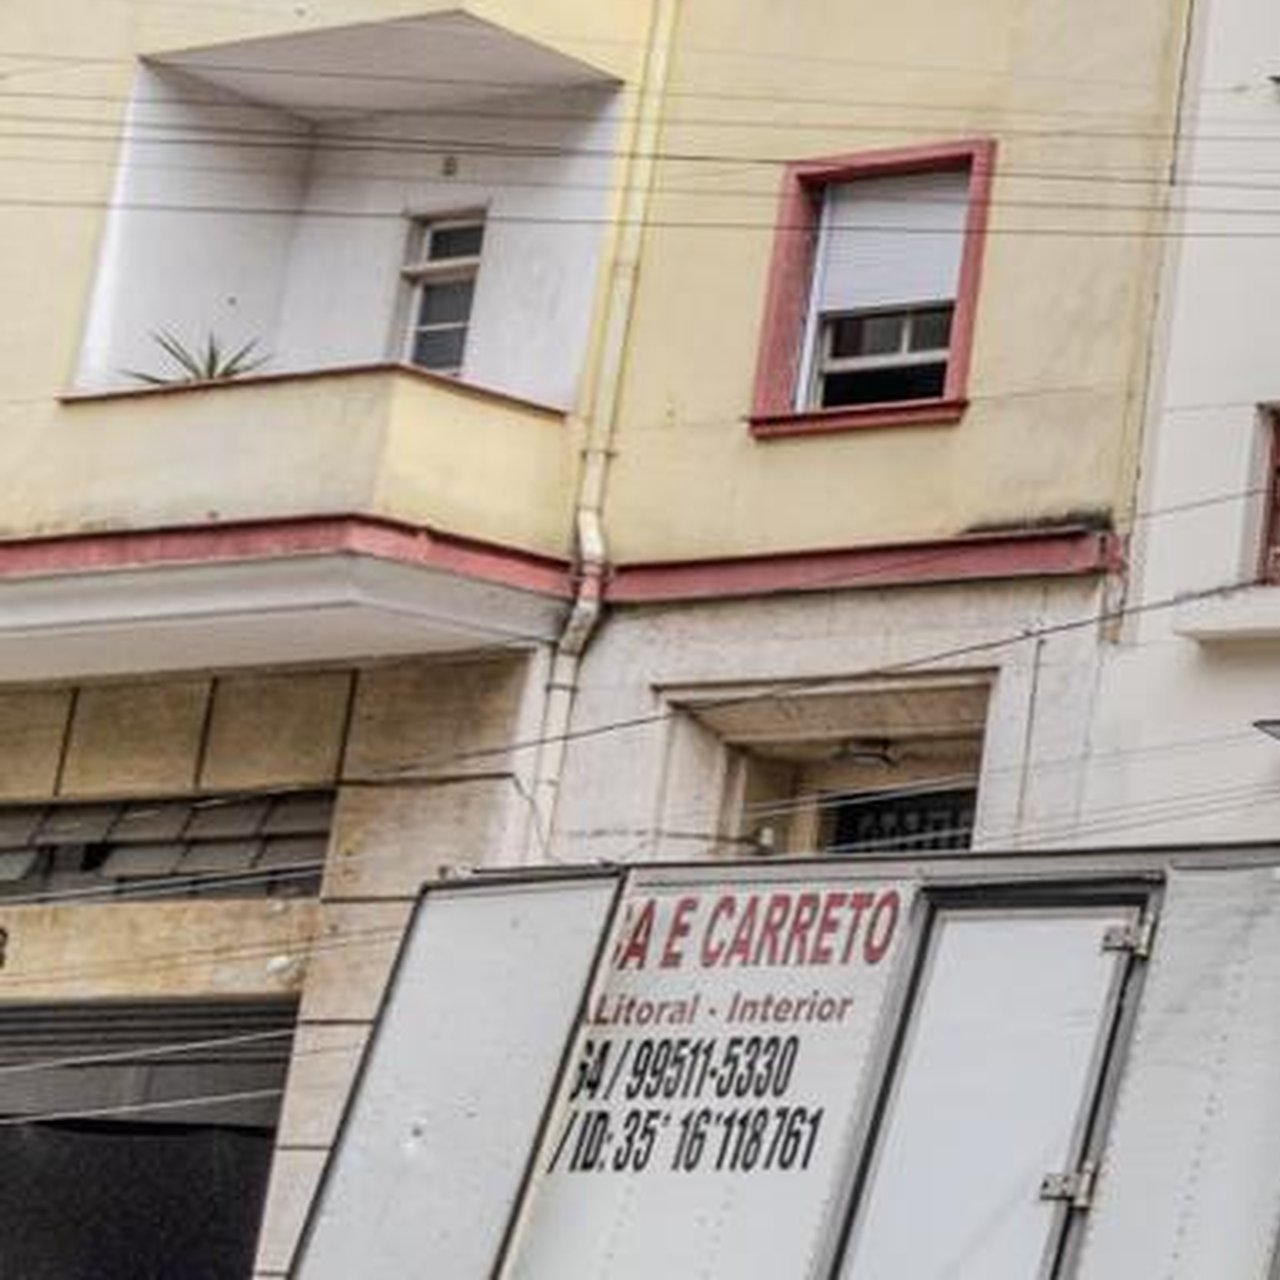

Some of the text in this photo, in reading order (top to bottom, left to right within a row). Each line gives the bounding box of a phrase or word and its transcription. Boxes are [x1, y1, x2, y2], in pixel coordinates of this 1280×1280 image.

[612, 889, 900, 971] A E CARRETO
[593, 993, 700, 1025] Litoral
[725, 989, 854, 1023] Interior
[626, 1035, 800, 1100] 99511-5330
